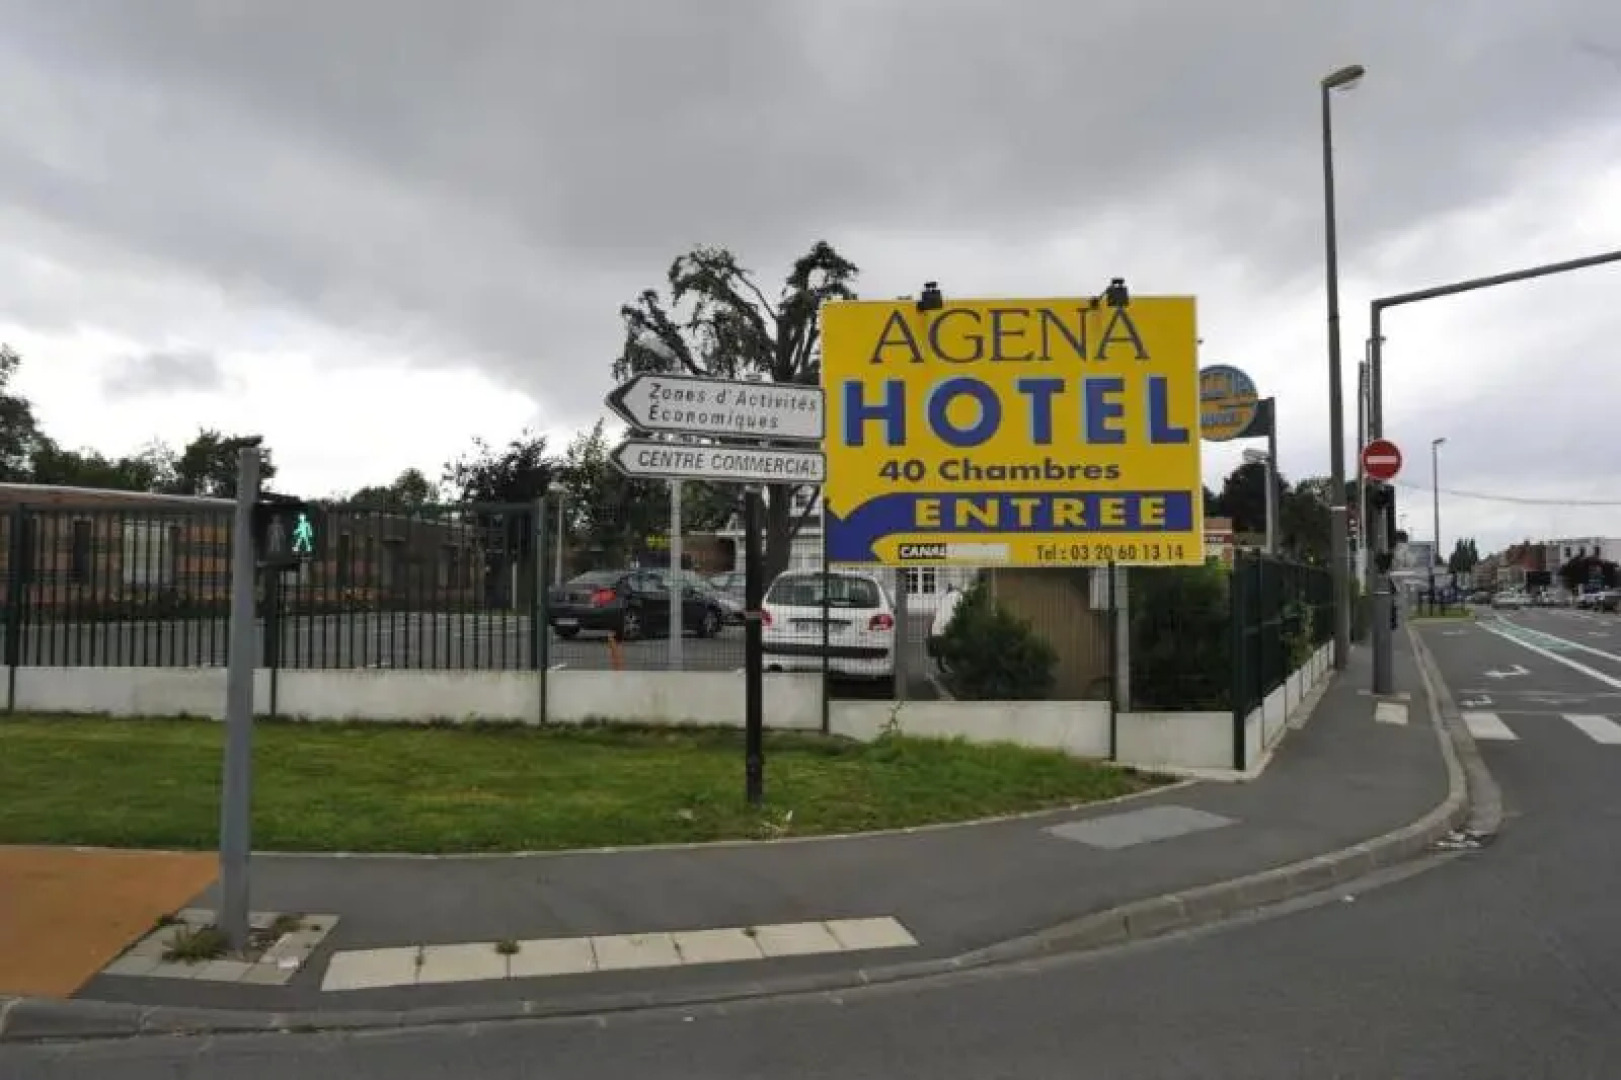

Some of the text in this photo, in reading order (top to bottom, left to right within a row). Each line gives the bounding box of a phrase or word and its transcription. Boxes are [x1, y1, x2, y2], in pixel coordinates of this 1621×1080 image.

[870, 307, 1150, 364] AGENA
[648, 382, 817, 413] Zones d'Activités
[842, 374, 1190, 448] HOTEL
[638, 450, 818, 475] CENTRE COMMERCIAL
[879, 458, 1121, 482] 40 Chambres
[915, 497, 1167, 528] ENTREE
[1071, 544, 1089, 560] 03
[1095, 544, 1113, 560] 20
[1119, 544, 1135, 560] 60
[1143, 544, 1160, 560] 13
[1167, 544, 1184, 560] 14
